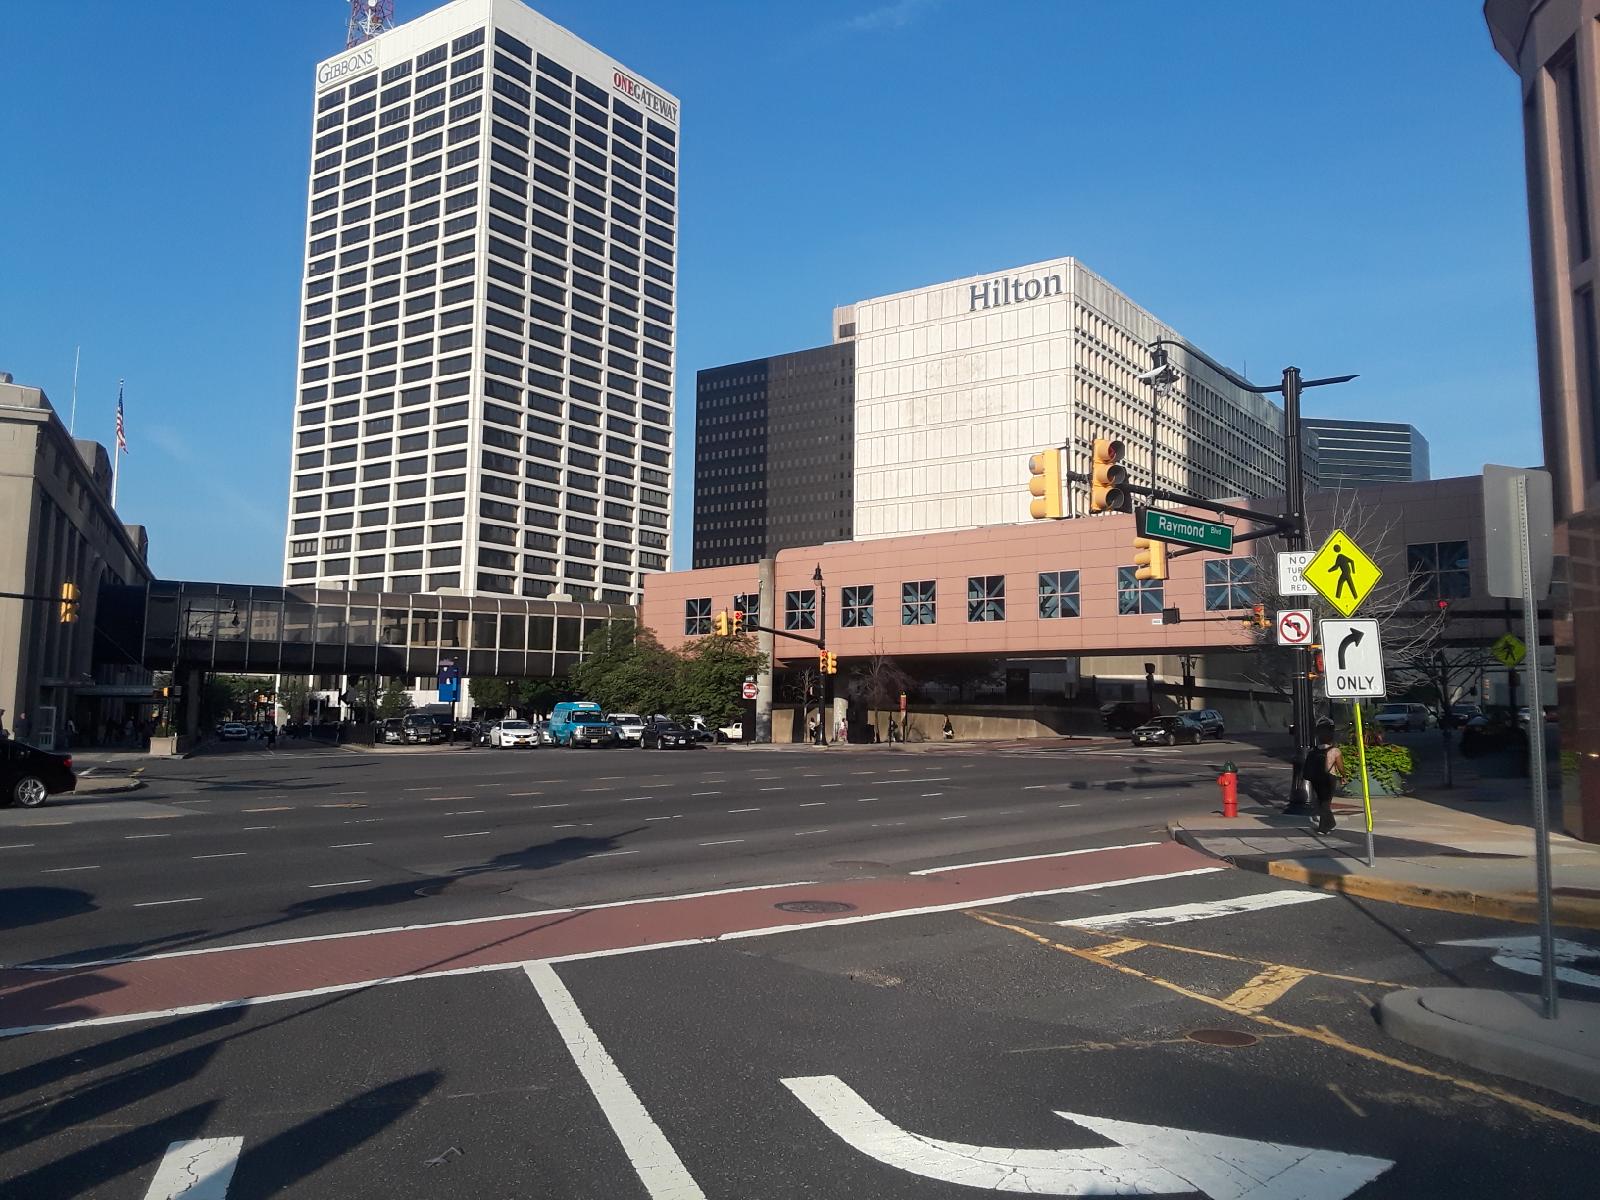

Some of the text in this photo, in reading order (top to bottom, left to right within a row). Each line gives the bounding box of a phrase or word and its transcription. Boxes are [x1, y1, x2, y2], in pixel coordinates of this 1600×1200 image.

[318, 49, 373, 84] GIBBONS
[969, 274, 1063, 311] Hilton
[1159, 516, 1222, 538] Raymond Blvd
[1289, 556, 1306, 564] NO
[1337, 676, 1374, 690] ONLY
